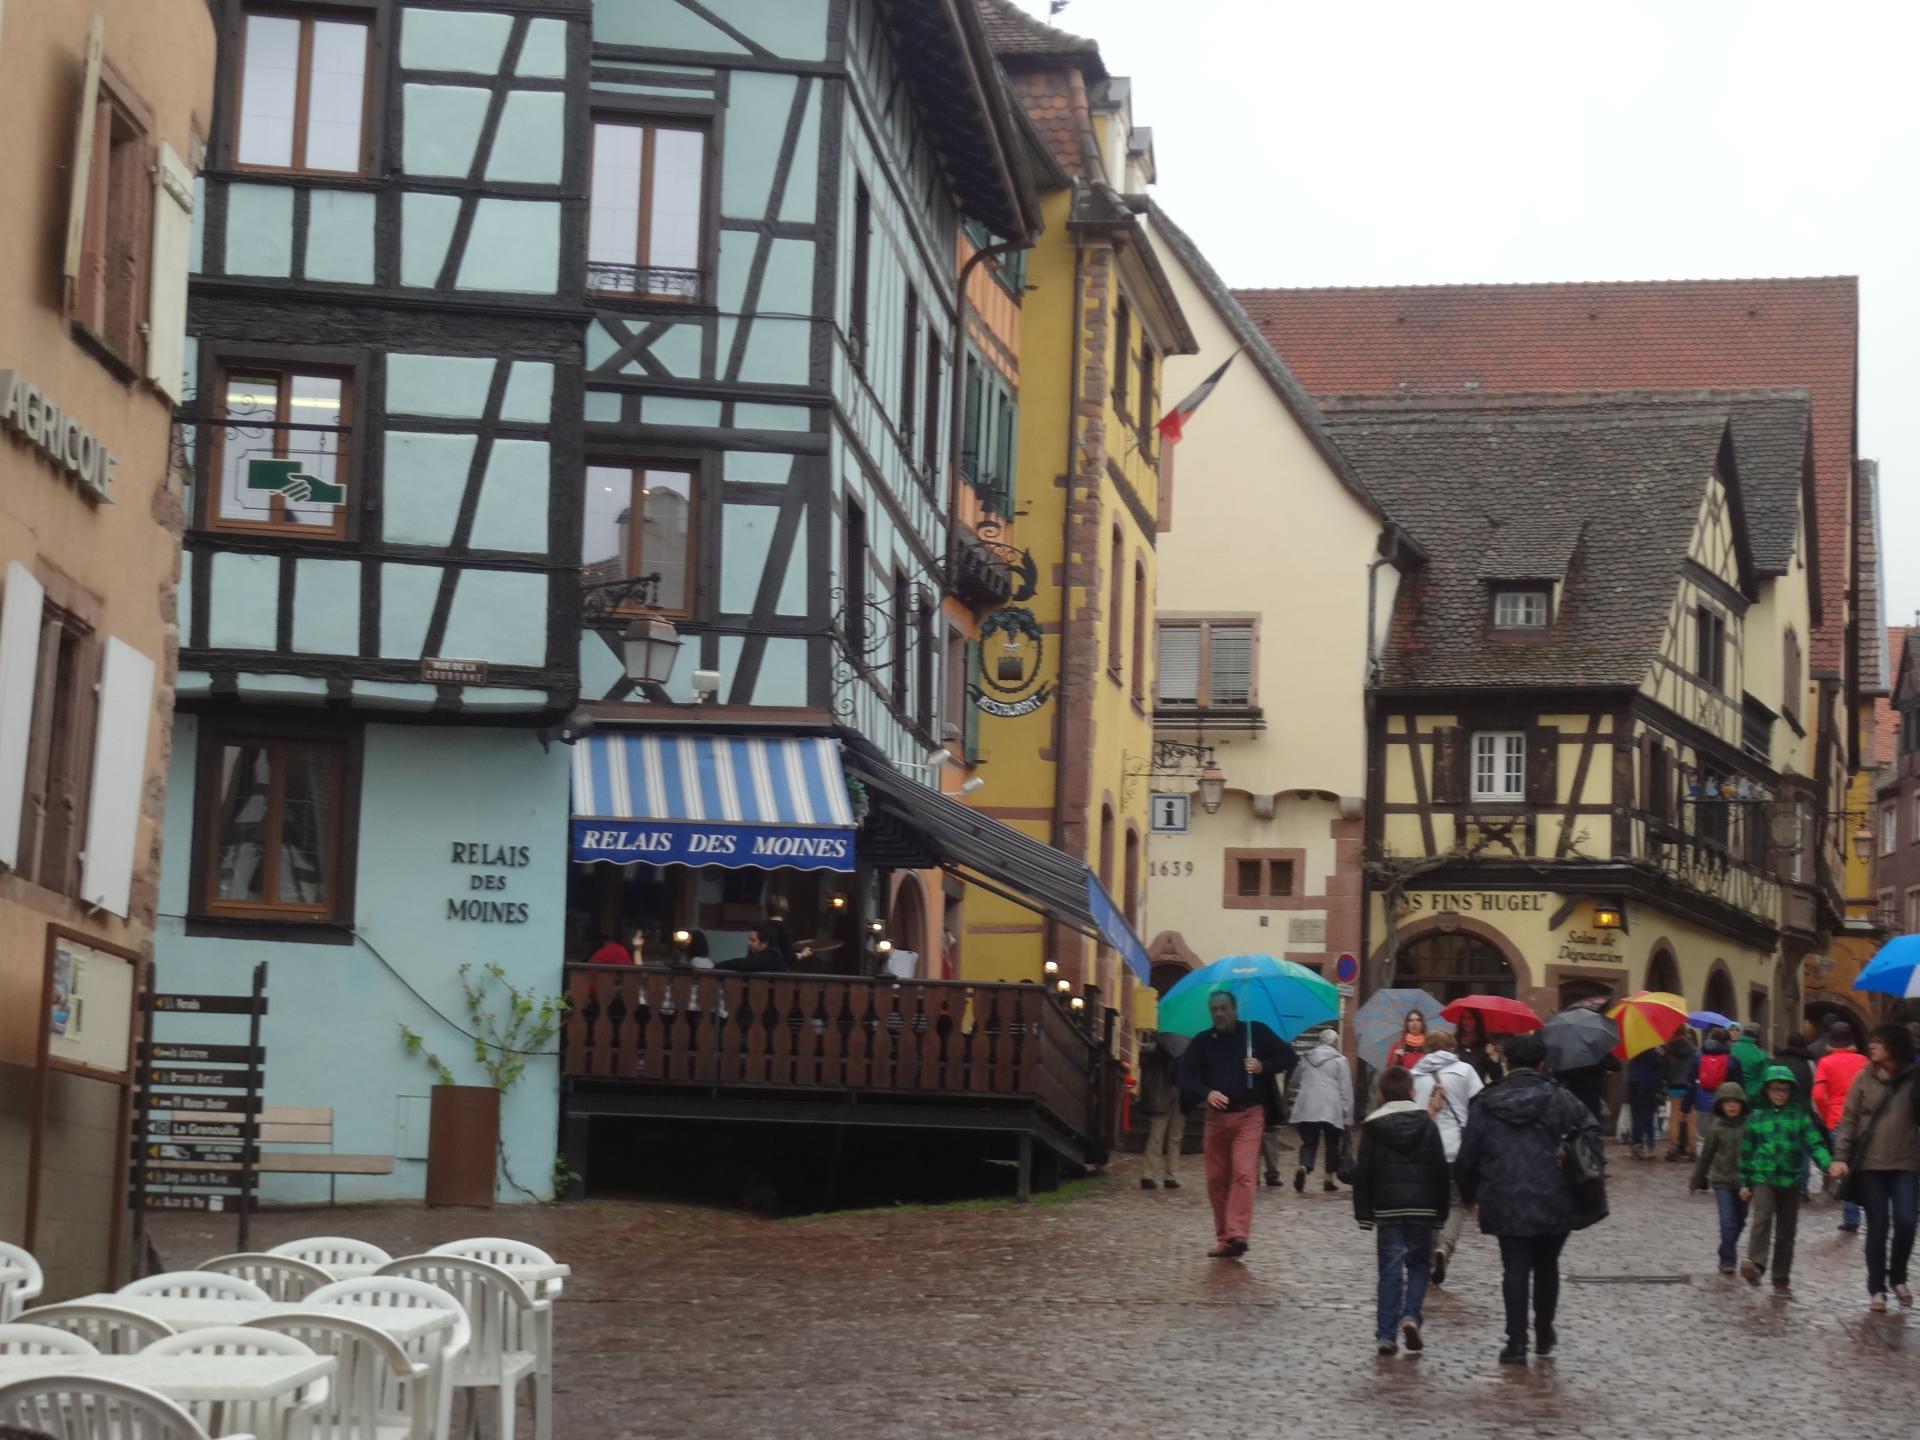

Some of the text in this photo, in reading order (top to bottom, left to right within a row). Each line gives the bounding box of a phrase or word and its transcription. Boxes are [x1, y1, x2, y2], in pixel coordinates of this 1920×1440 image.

[1, 370, 118, 505] AGRICOLE
[450, 841, 531, 867] RELAIS
[582, 830, 848, 858] RELAIS DES MOINES
[470, 874, 507, 890] DES
[446, 898, 530, 924] MOINES
[1432, 893, 1473, 911] FINS
